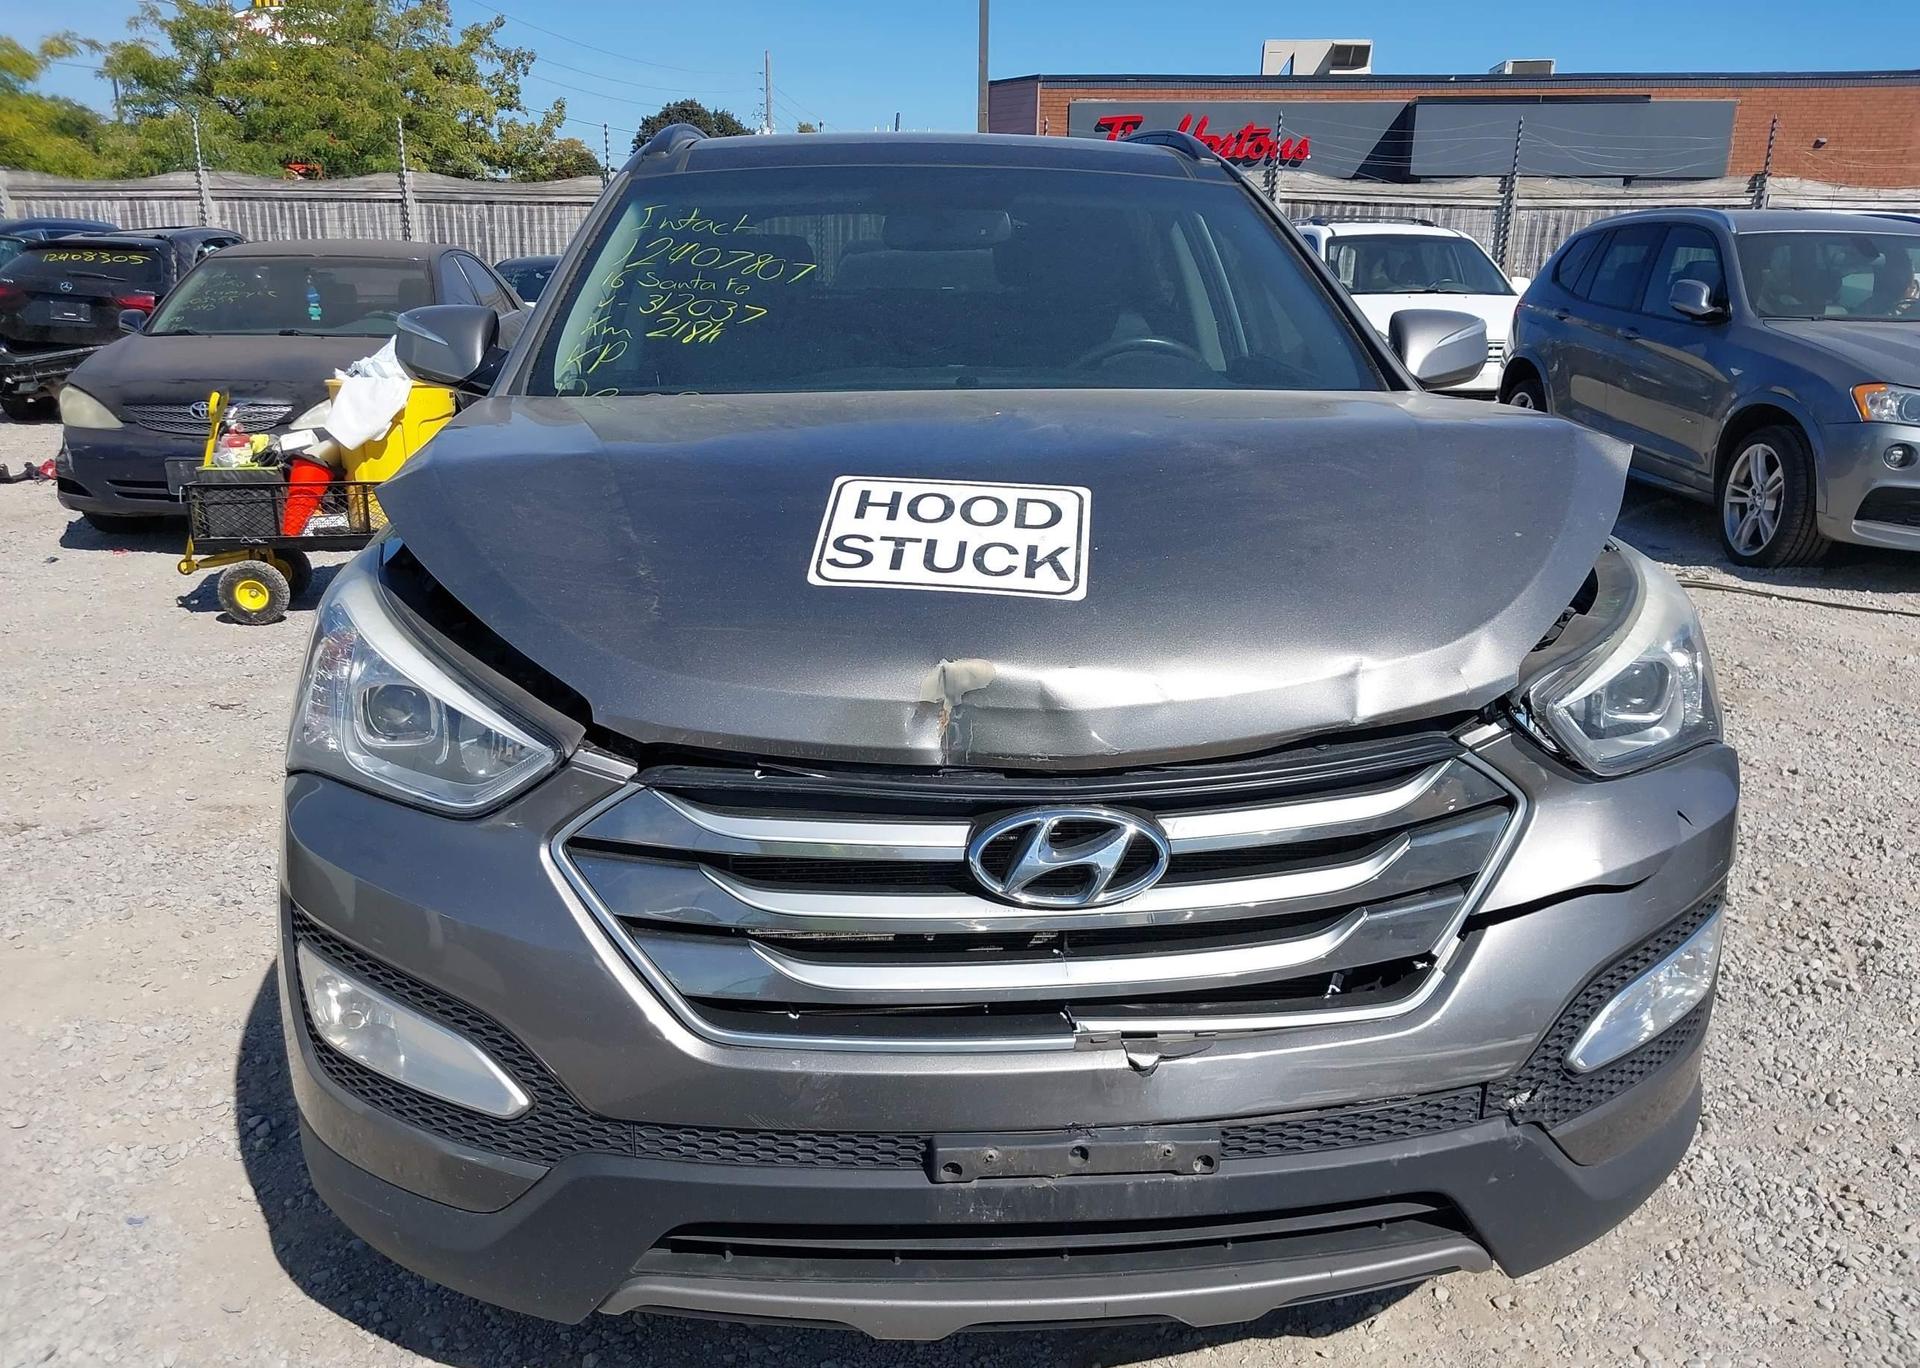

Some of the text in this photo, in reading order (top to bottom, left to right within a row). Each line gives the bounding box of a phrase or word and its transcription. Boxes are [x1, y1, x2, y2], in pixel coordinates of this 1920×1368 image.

[632, 205, 761, 235] Intact
[42, 251, 152, 266] 12408305
[637, 271, 716, 291] Santa
[726, 276, 751, 295] Fe
[853, 489, 1063, 530] HOOD
[825, 533, 1073, 583] STUCK
